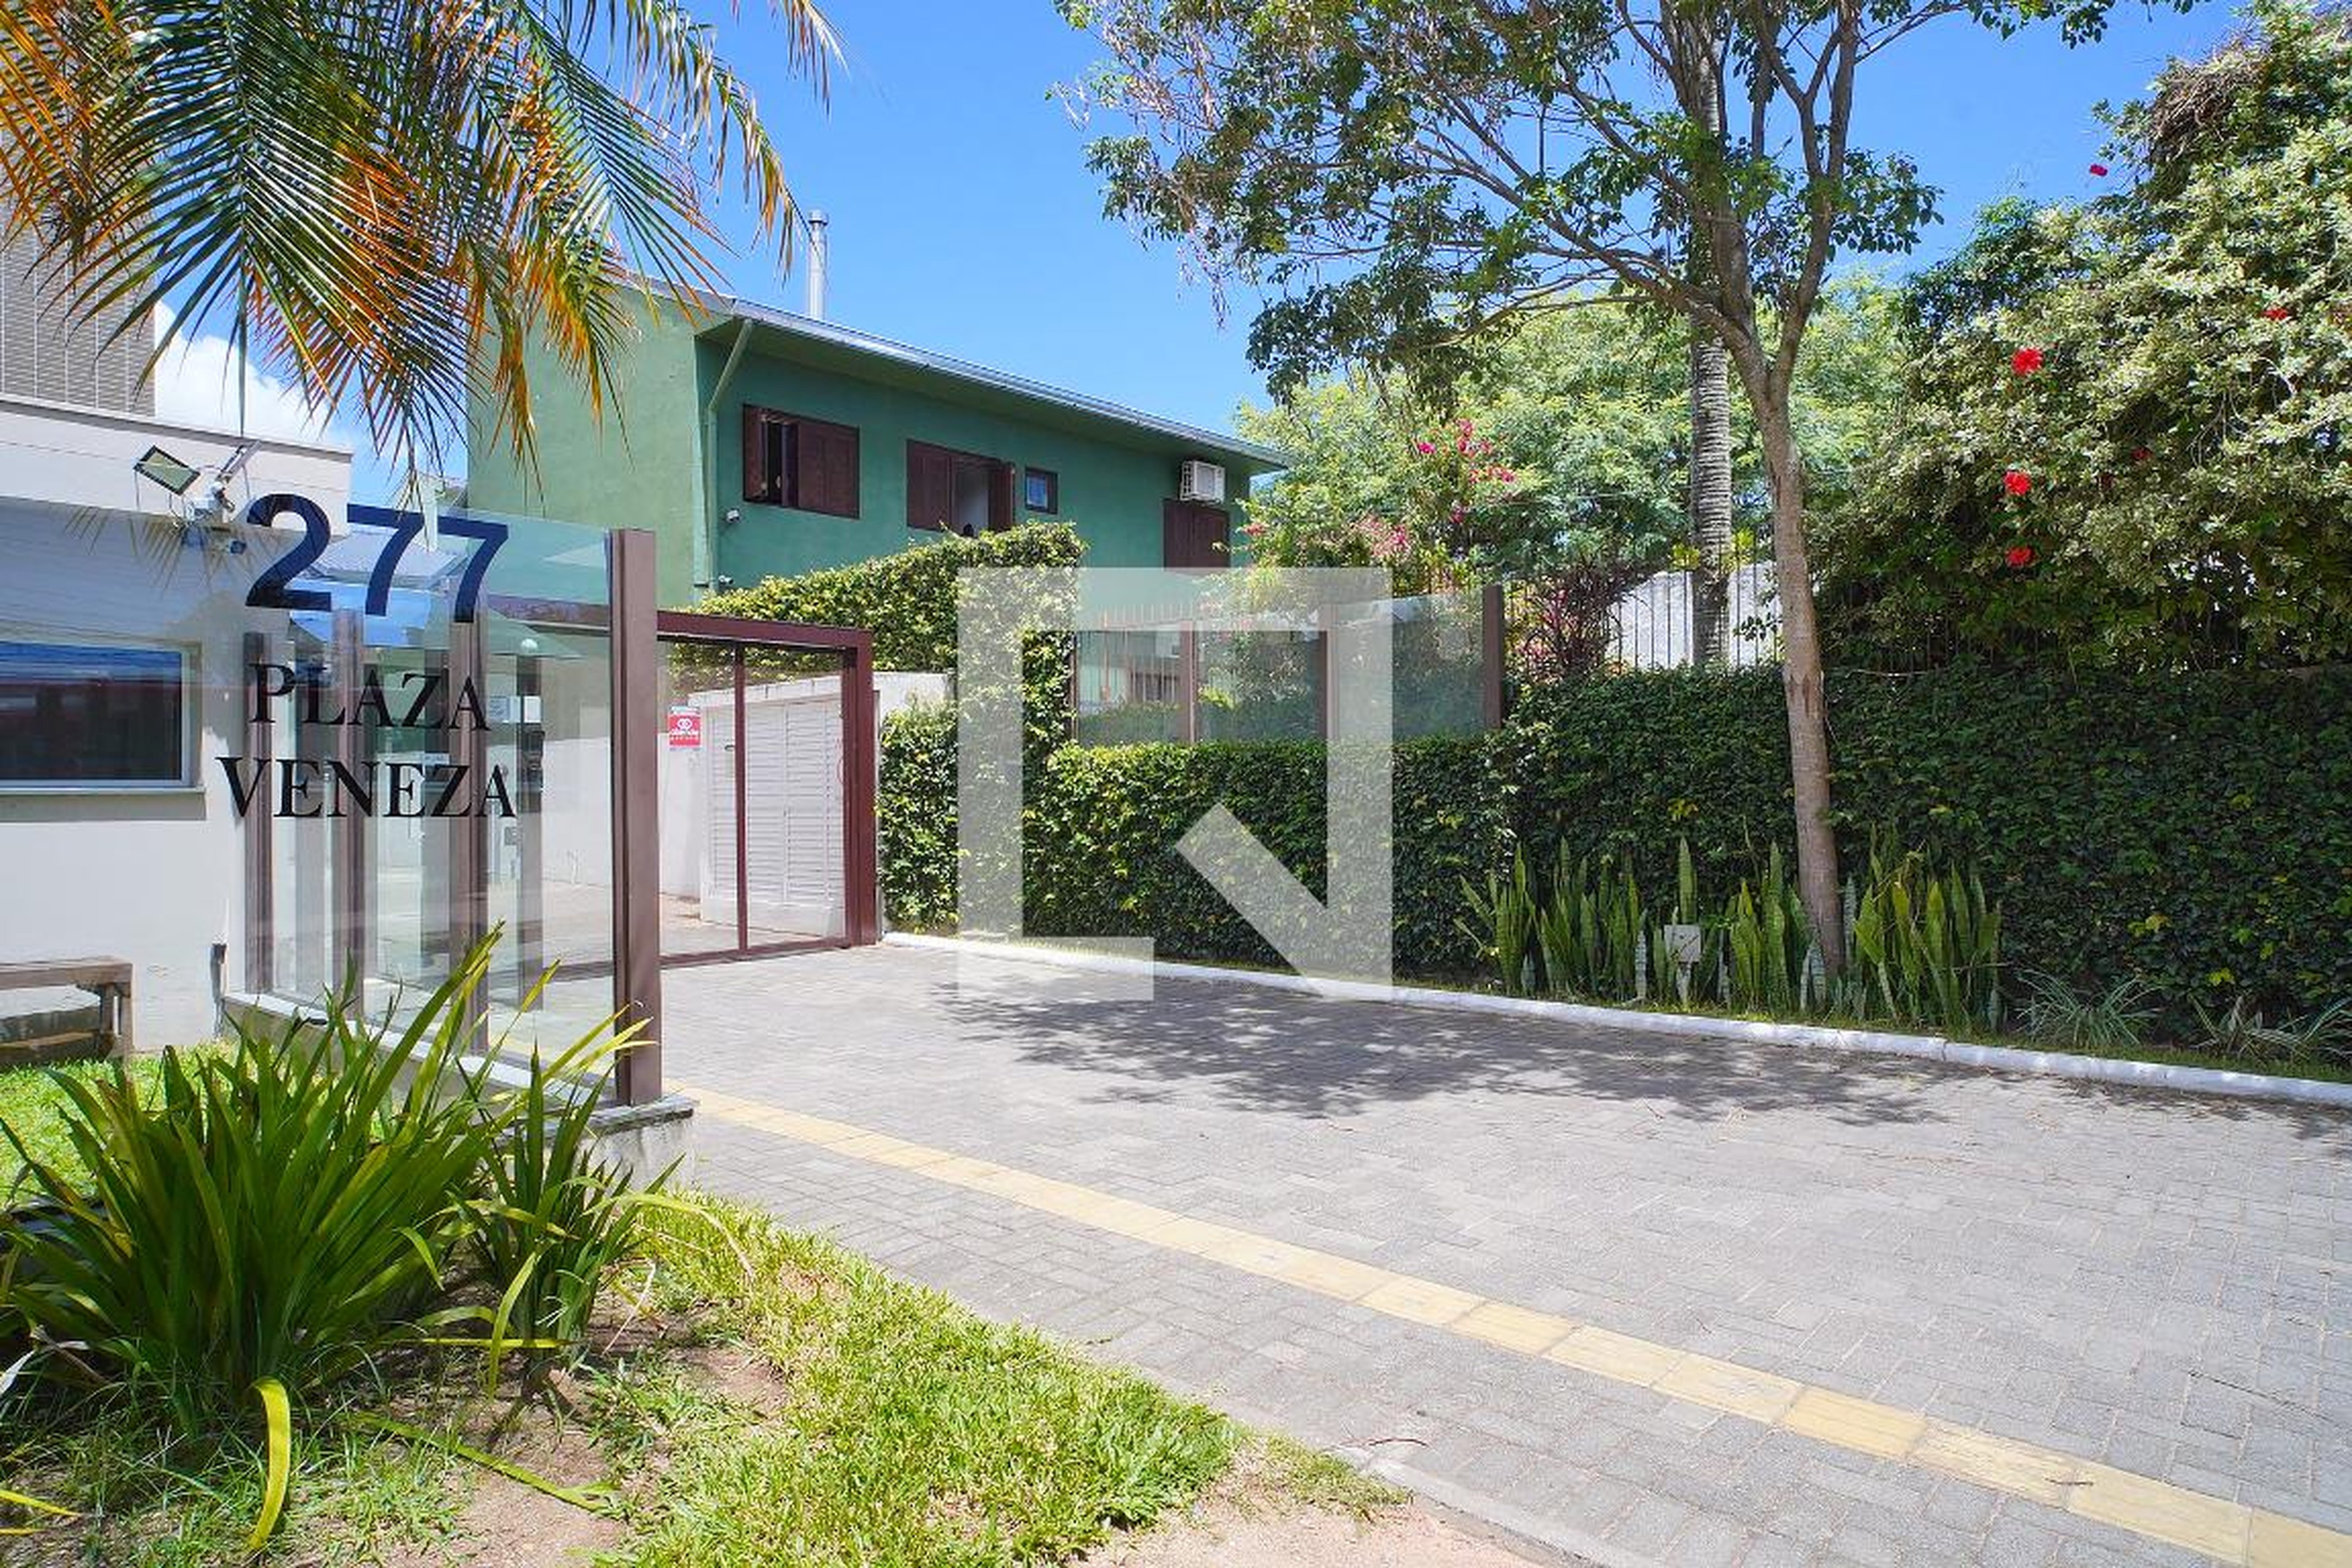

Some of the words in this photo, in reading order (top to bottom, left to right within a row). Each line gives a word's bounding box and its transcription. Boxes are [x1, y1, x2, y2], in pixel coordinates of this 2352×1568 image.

[246, 494, 509, 623] 277
[248, 663, 490, 730] PLAZA
[215, 756, 516, 818] VENEZA
